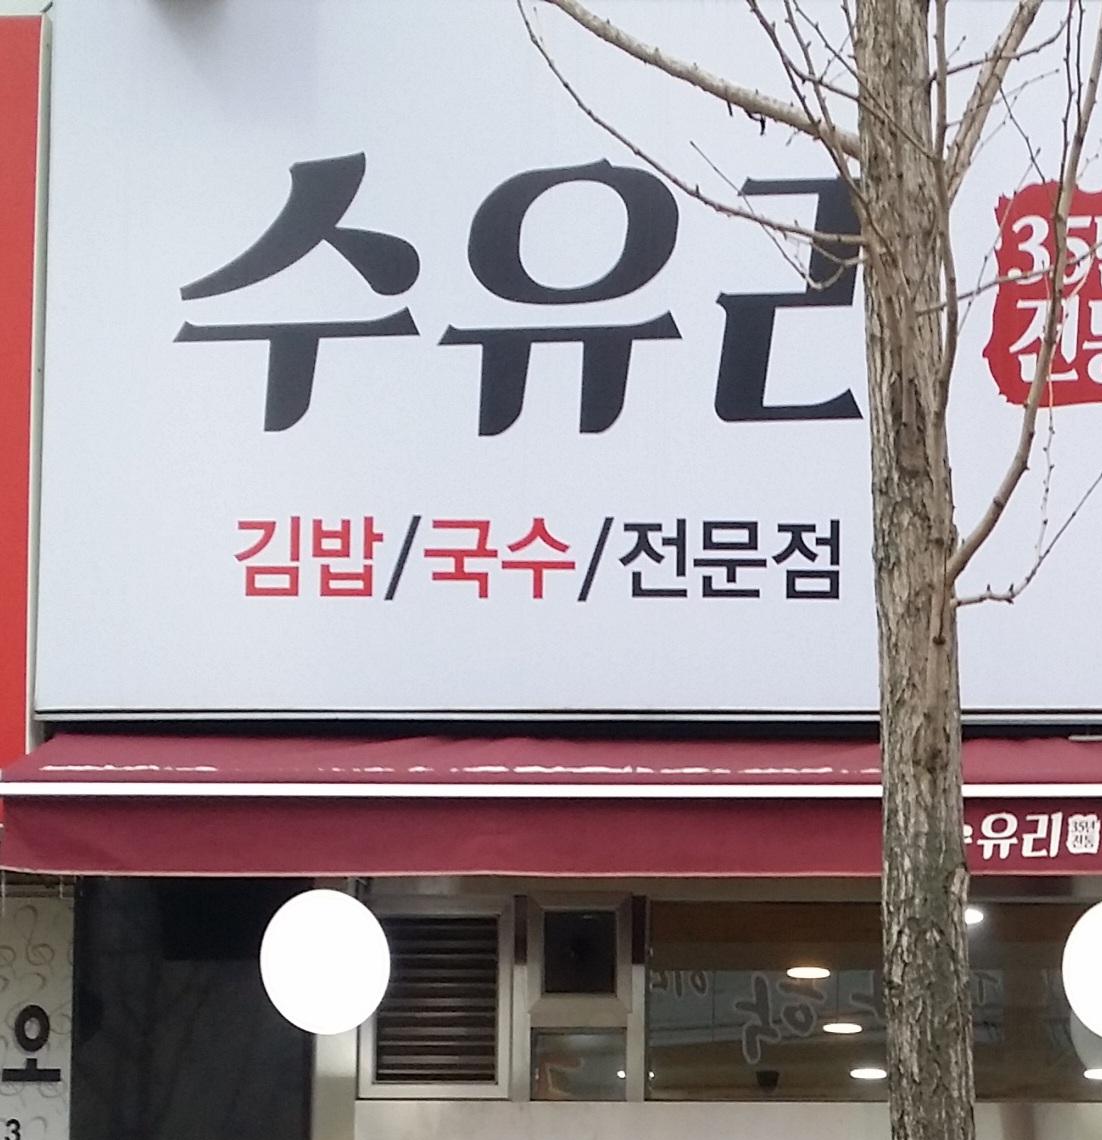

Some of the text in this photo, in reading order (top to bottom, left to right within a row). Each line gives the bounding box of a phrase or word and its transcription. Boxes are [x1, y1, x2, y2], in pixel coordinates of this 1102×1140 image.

[173, 152, 865, 436] 수유리
[233, 515, 841, 602] 김밥/국수/전문점
[963, 810, 1063, 859] 유리
